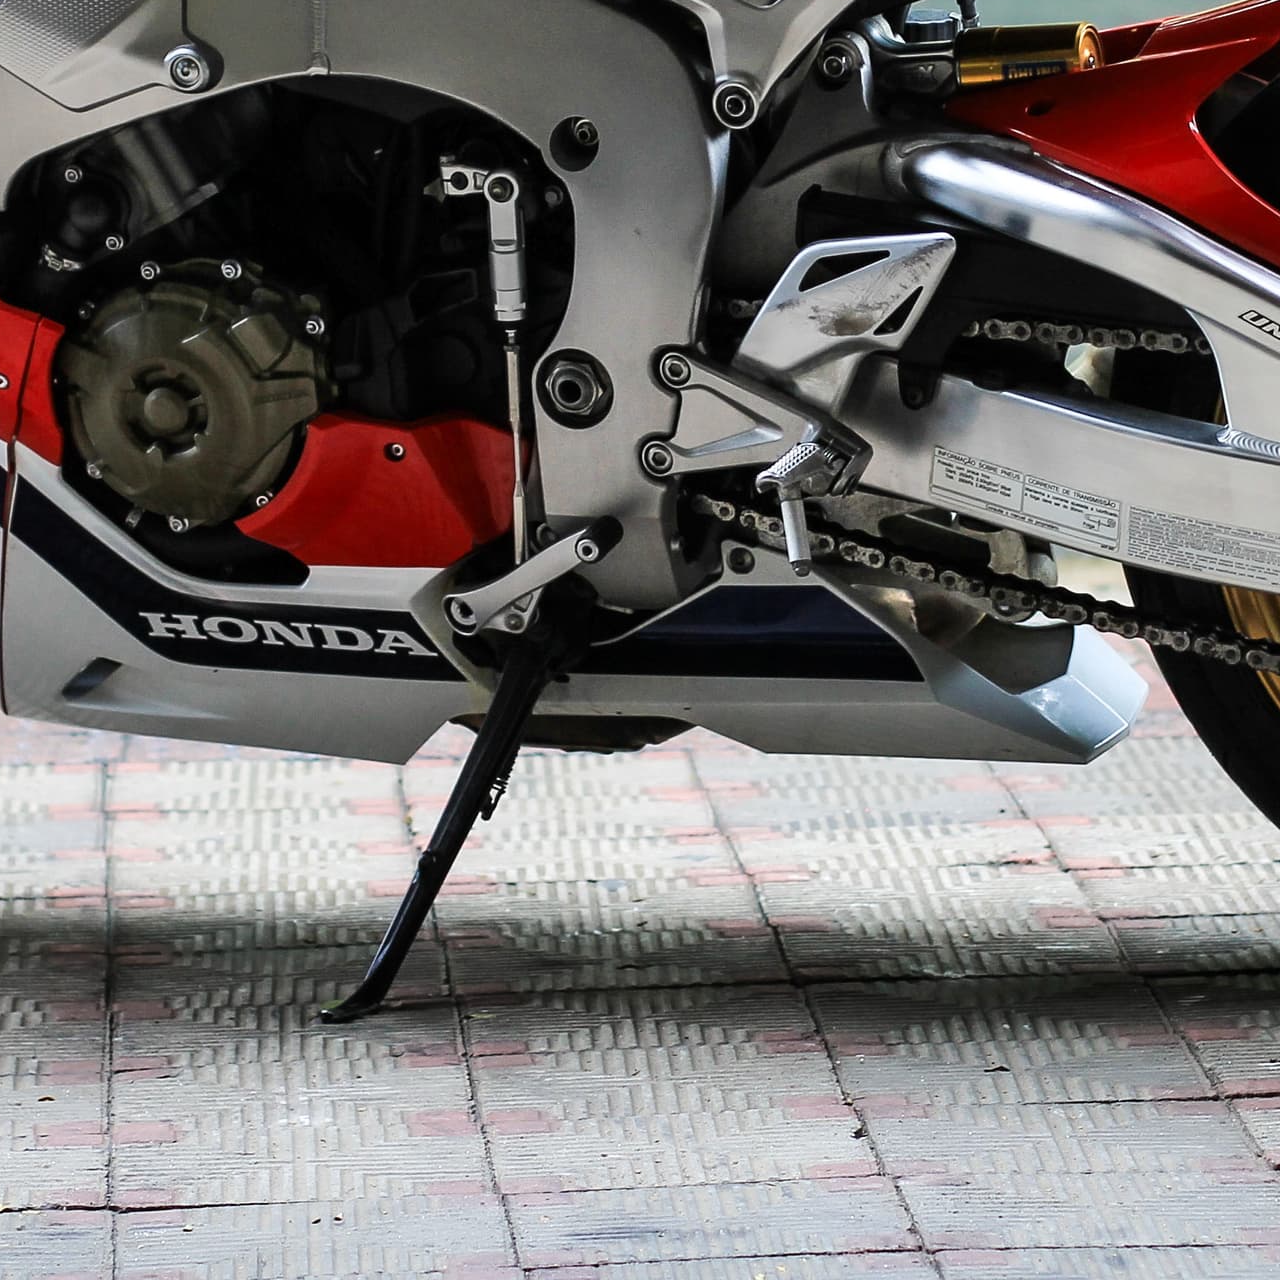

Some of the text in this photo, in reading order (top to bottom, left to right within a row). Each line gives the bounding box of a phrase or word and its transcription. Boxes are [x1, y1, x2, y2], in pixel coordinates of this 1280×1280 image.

[978, 462, 999, 473] SOBRE
[1000, 469, 1021, 481] PNEUS
[1062, 488, 1070, 496] DE
[138, 612, 439, 656] HONDA
